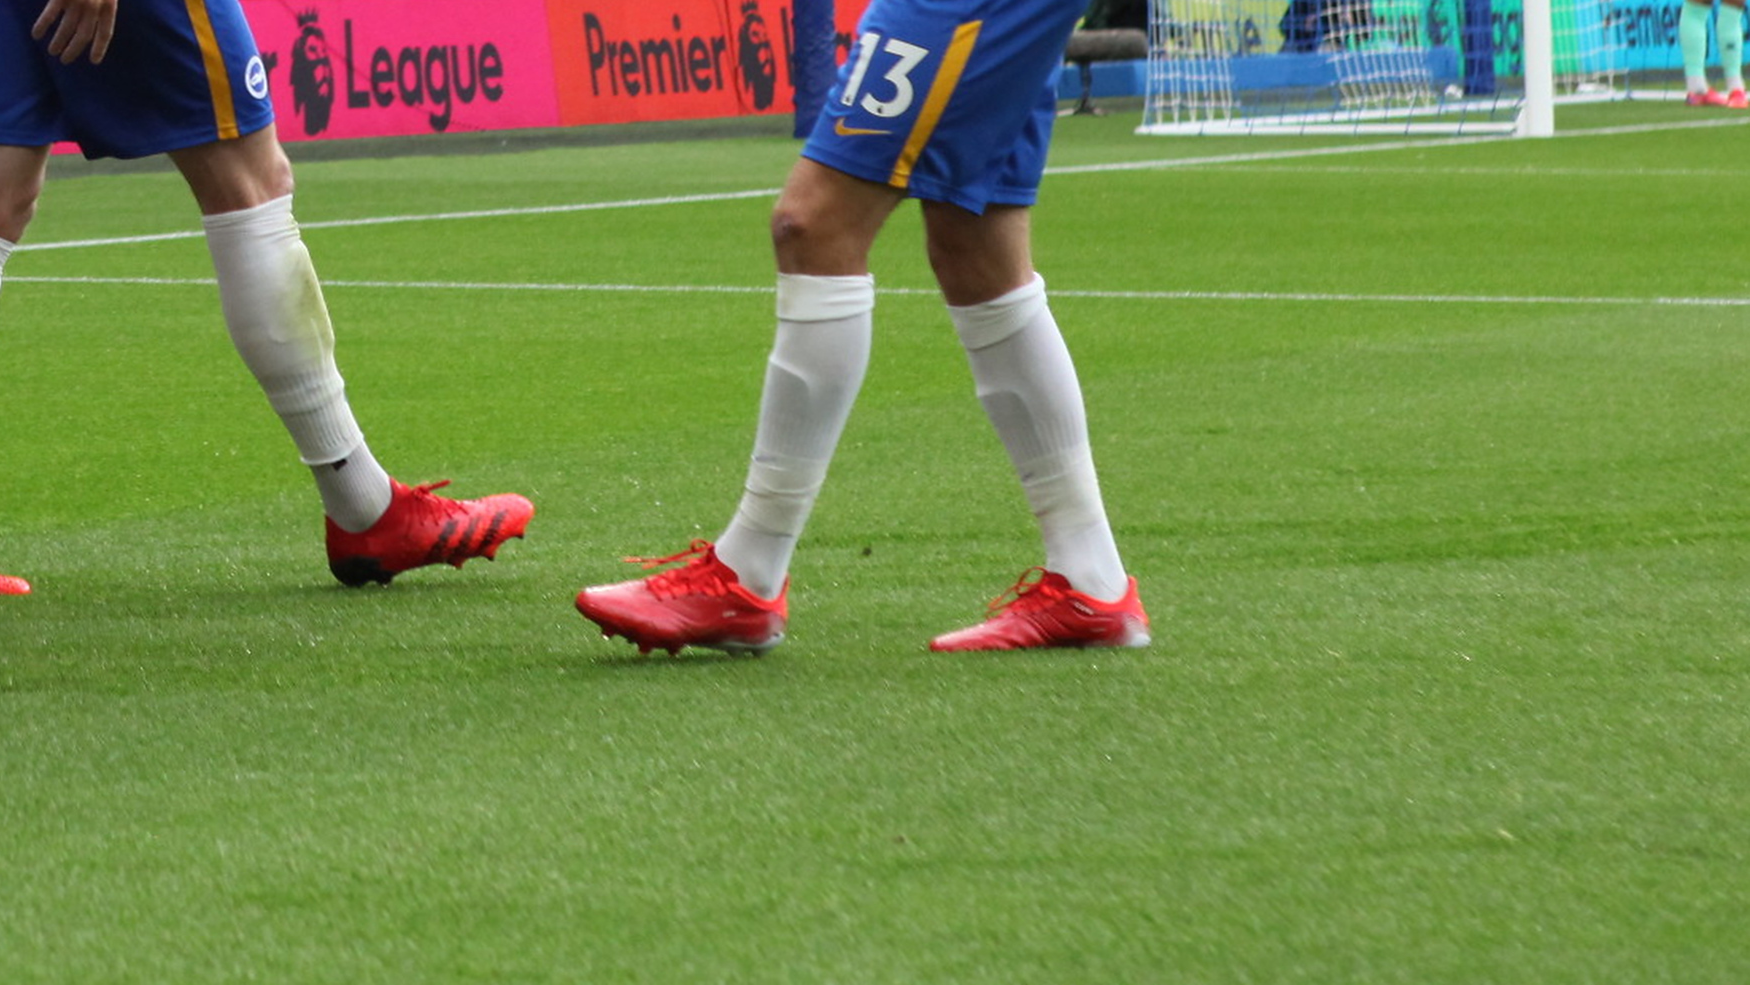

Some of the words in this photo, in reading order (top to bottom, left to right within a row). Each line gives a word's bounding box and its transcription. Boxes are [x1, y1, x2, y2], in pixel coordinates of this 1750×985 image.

[344, 18, 505, 133] League
[582, 13, 727, 98] Premier
[840, 31, 931, 119] 13
